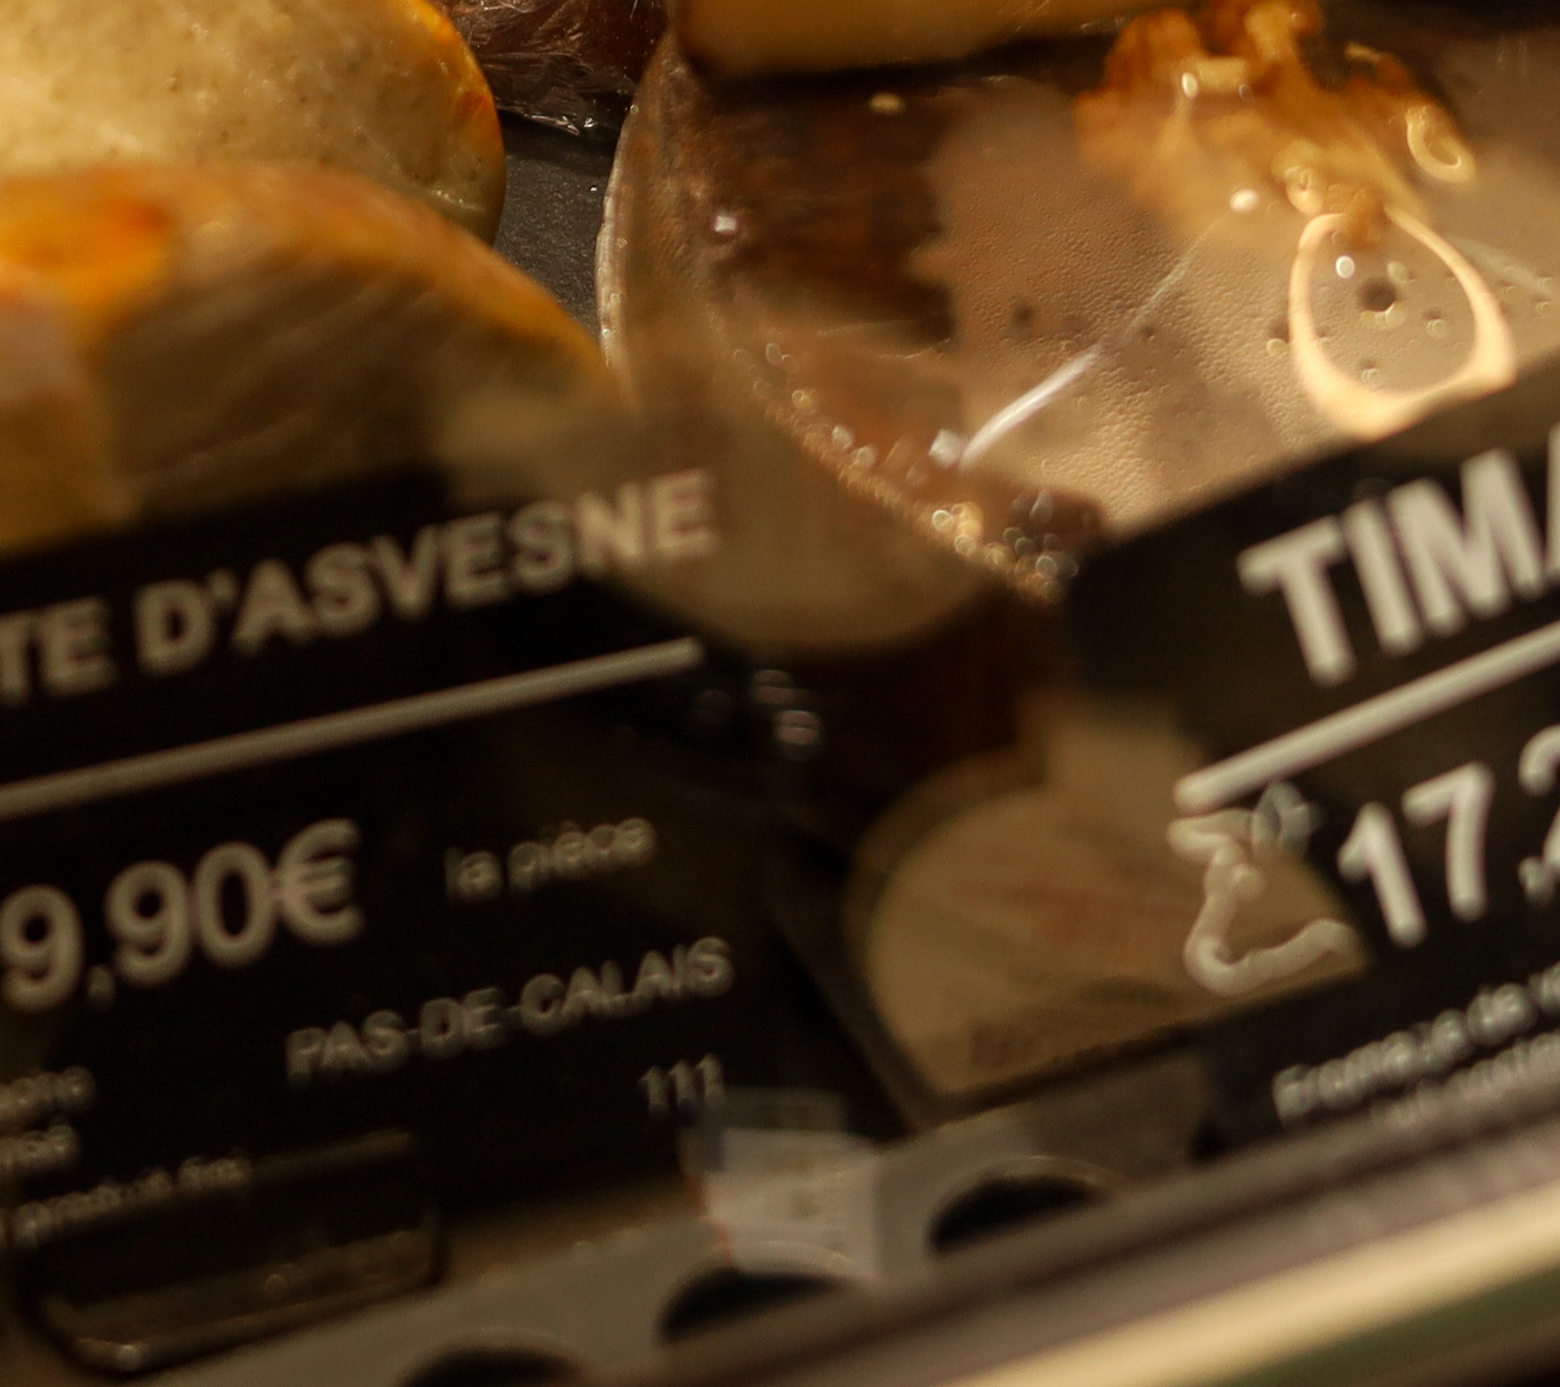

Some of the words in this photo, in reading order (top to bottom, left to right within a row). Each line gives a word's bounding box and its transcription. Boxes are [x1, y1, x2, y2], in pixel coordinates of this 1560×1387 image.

[132, 465, 720, 674] D'ASVESNE
[444, 846, 504, 904] la
[638, 1051, 727, 1118] 111
